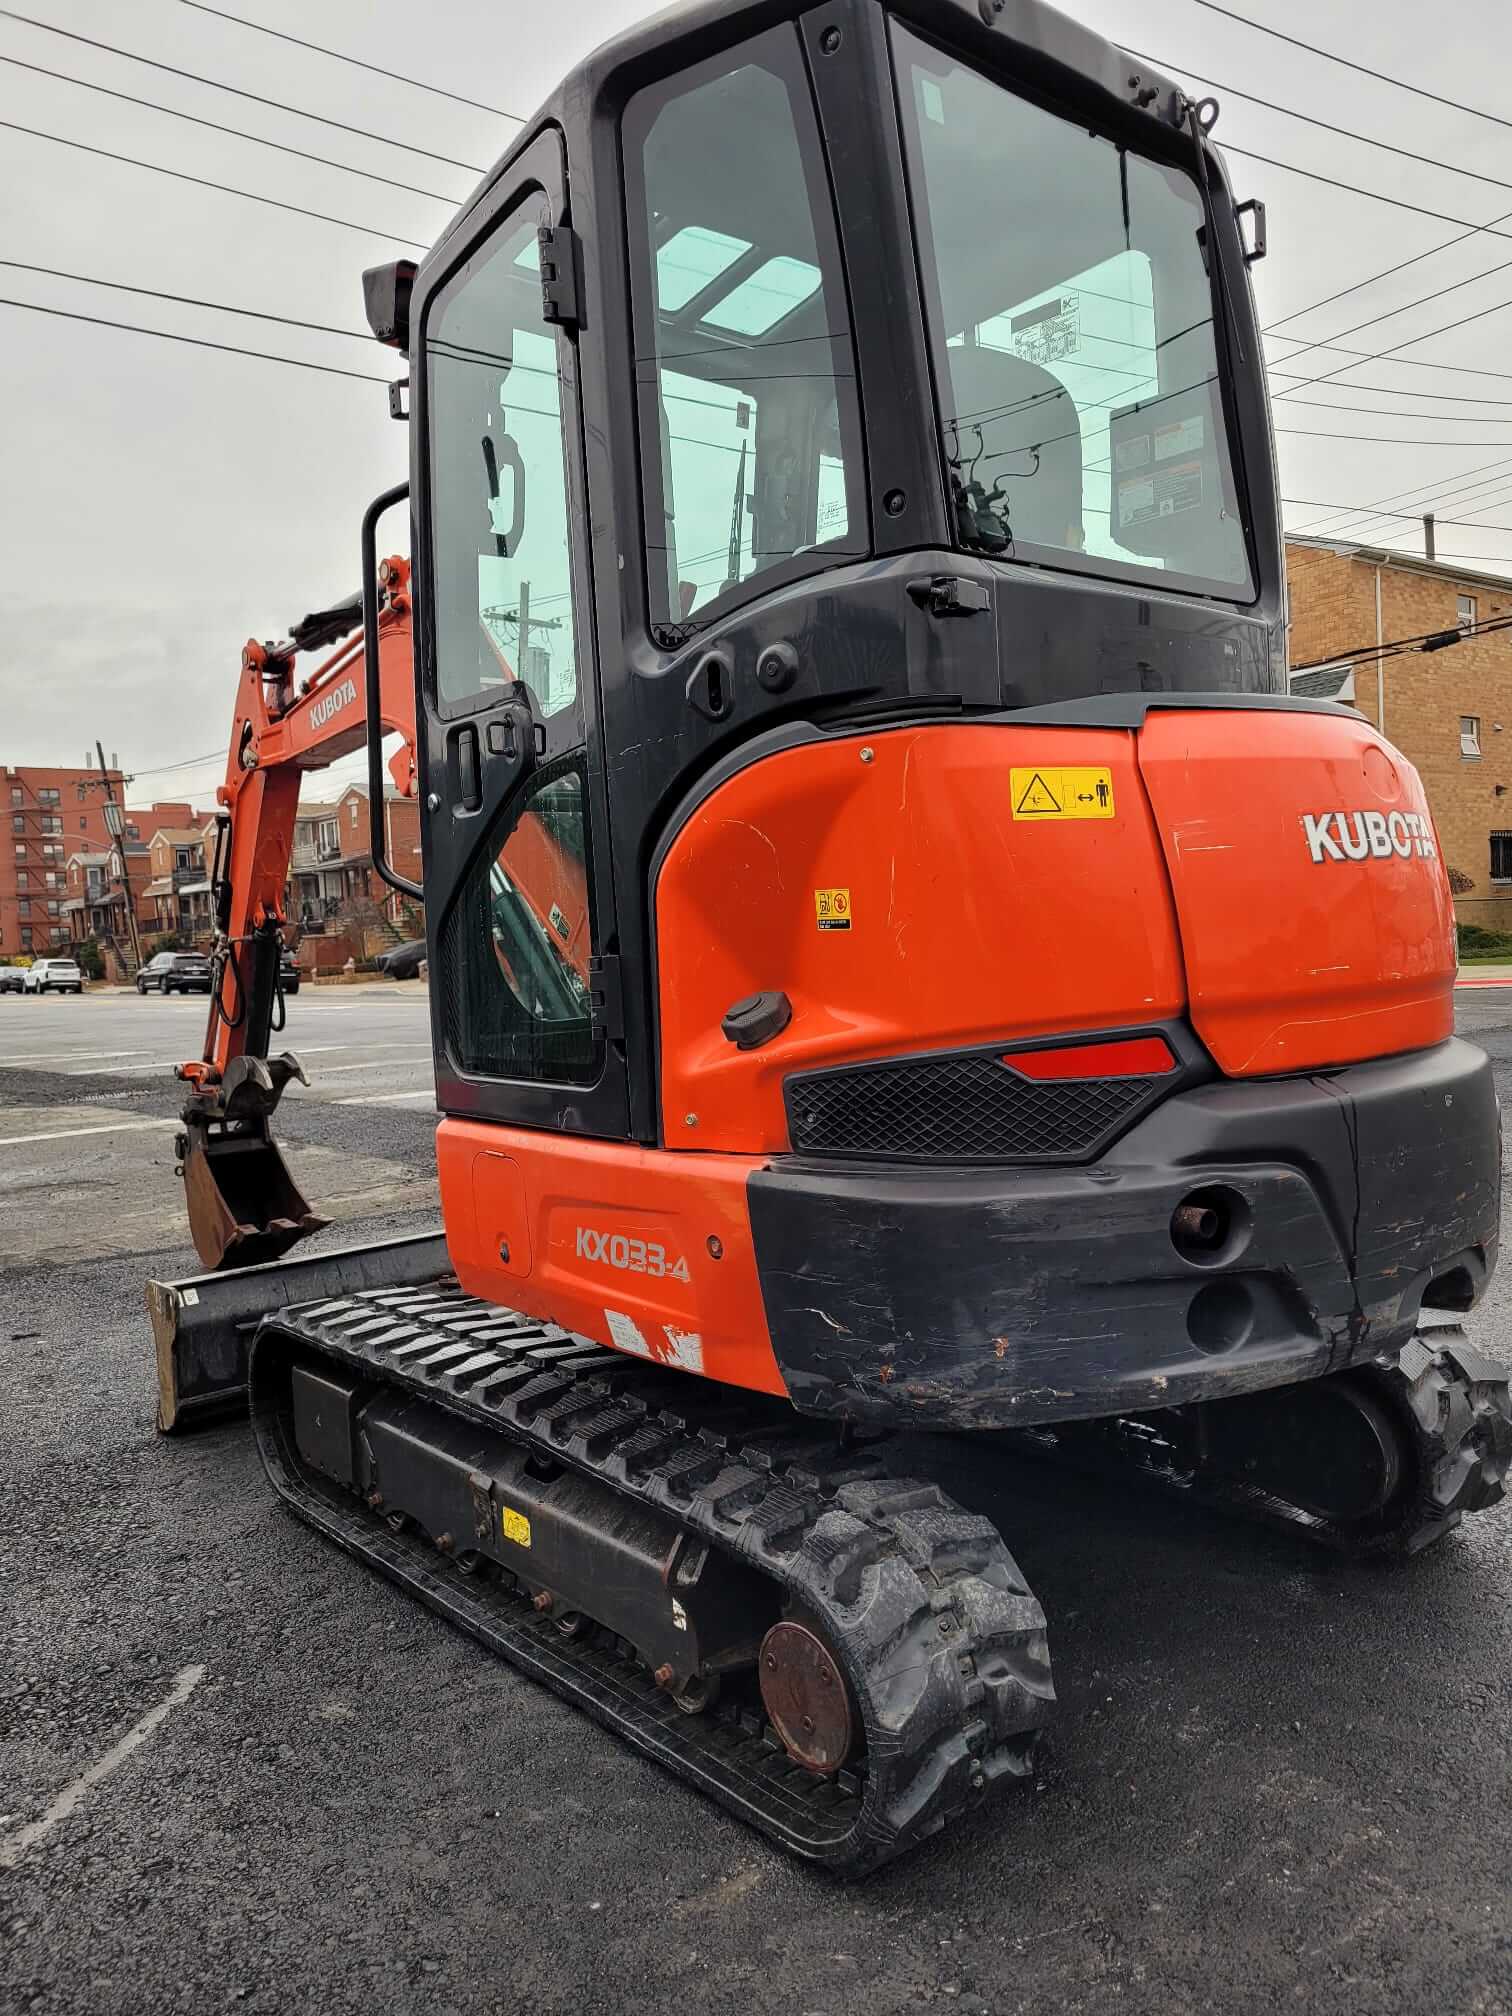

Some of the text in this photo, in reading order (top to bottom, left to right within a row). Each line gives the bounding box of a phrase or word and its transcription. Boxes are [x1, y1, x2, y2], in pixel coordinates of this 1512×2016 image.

[310, 679, 357, 730] KUBOTA
[1303, 811, 1436, 863] KUBOTA
[576, 1226, 691, 1283] KX033-4
